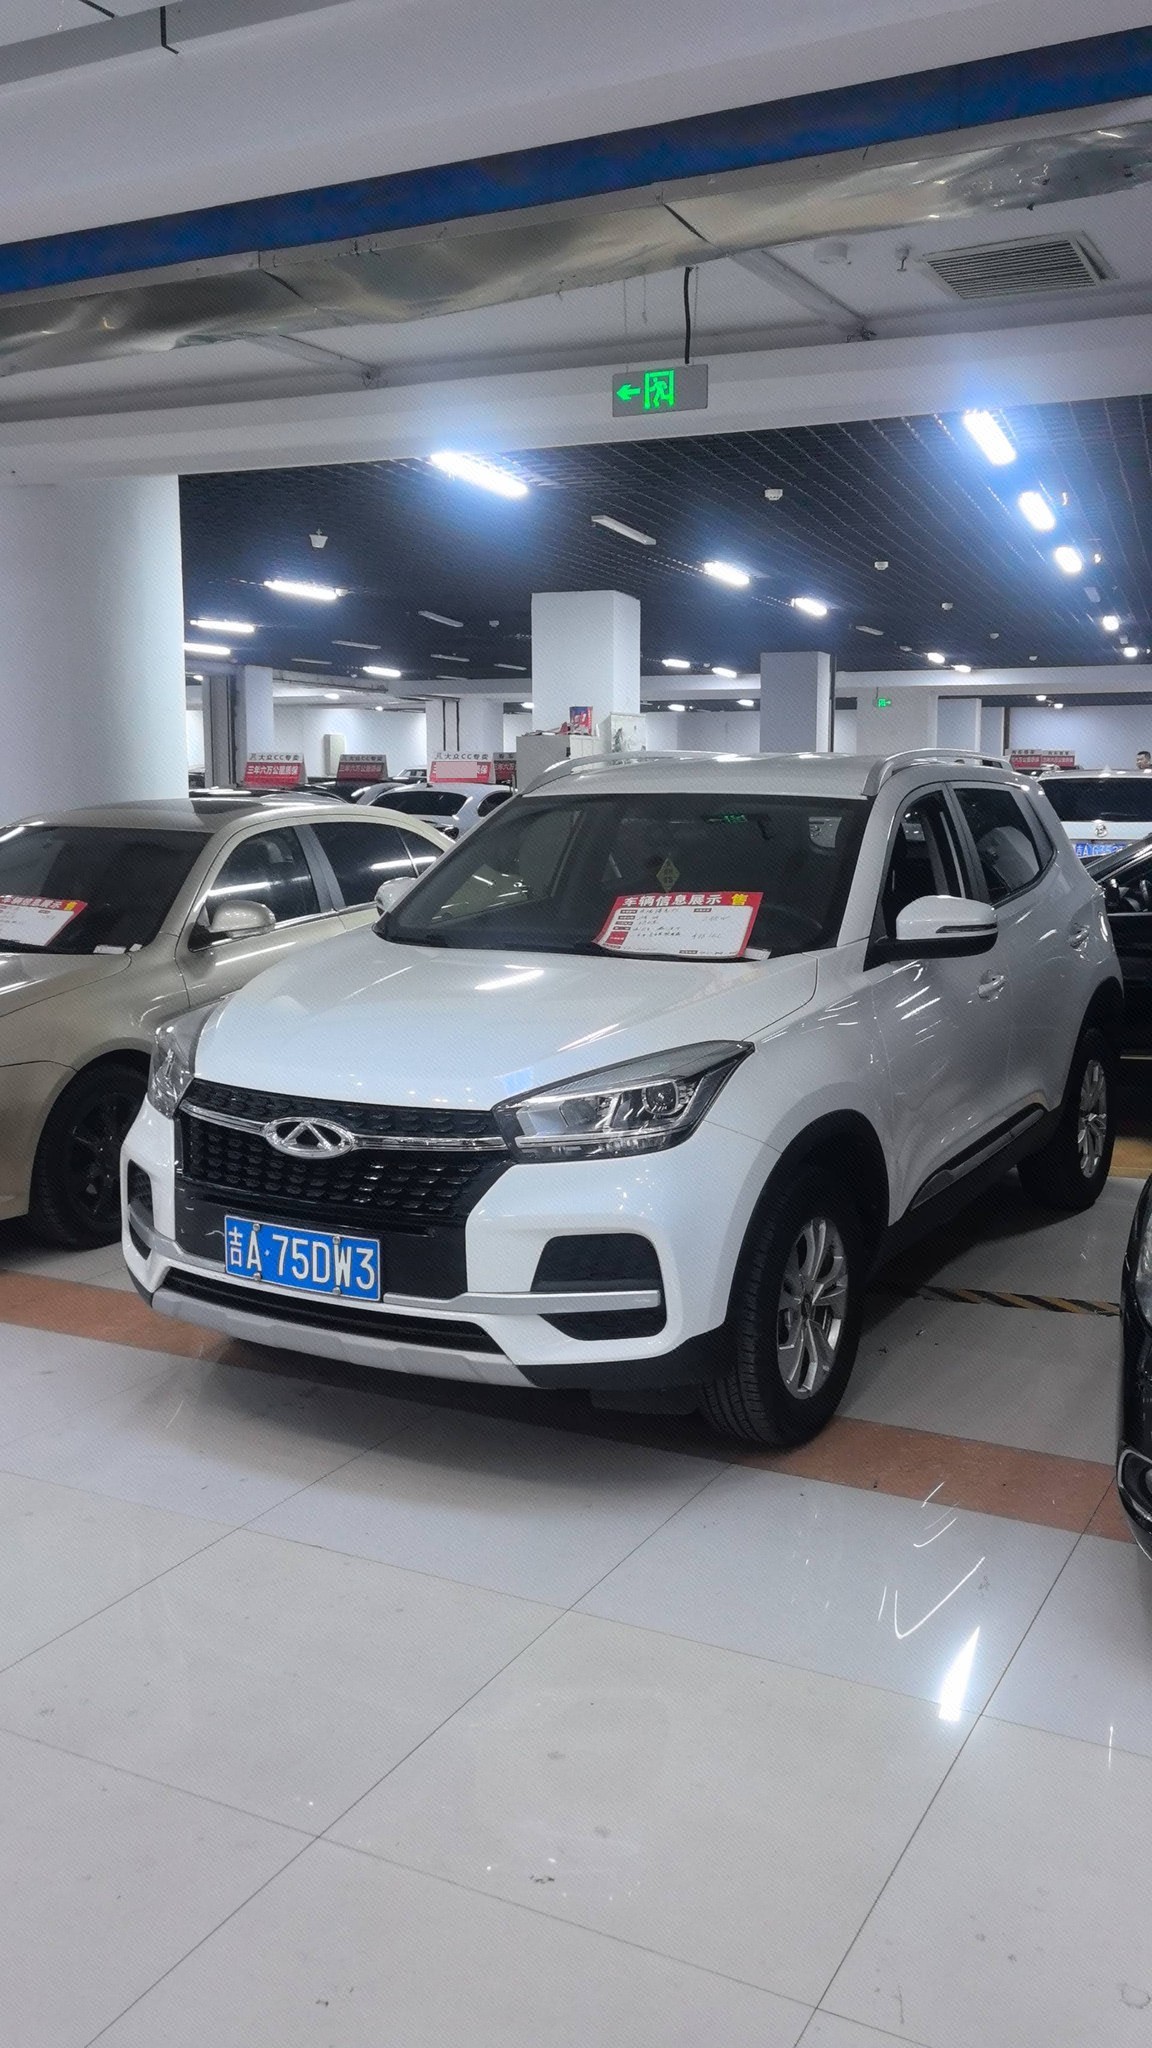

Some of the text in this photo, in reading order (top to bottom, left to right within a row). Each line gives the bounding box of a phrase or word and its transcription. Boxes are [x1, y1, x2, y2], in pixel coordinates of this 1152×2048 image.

[622, 893, 723, 907] 车辆信息展示
